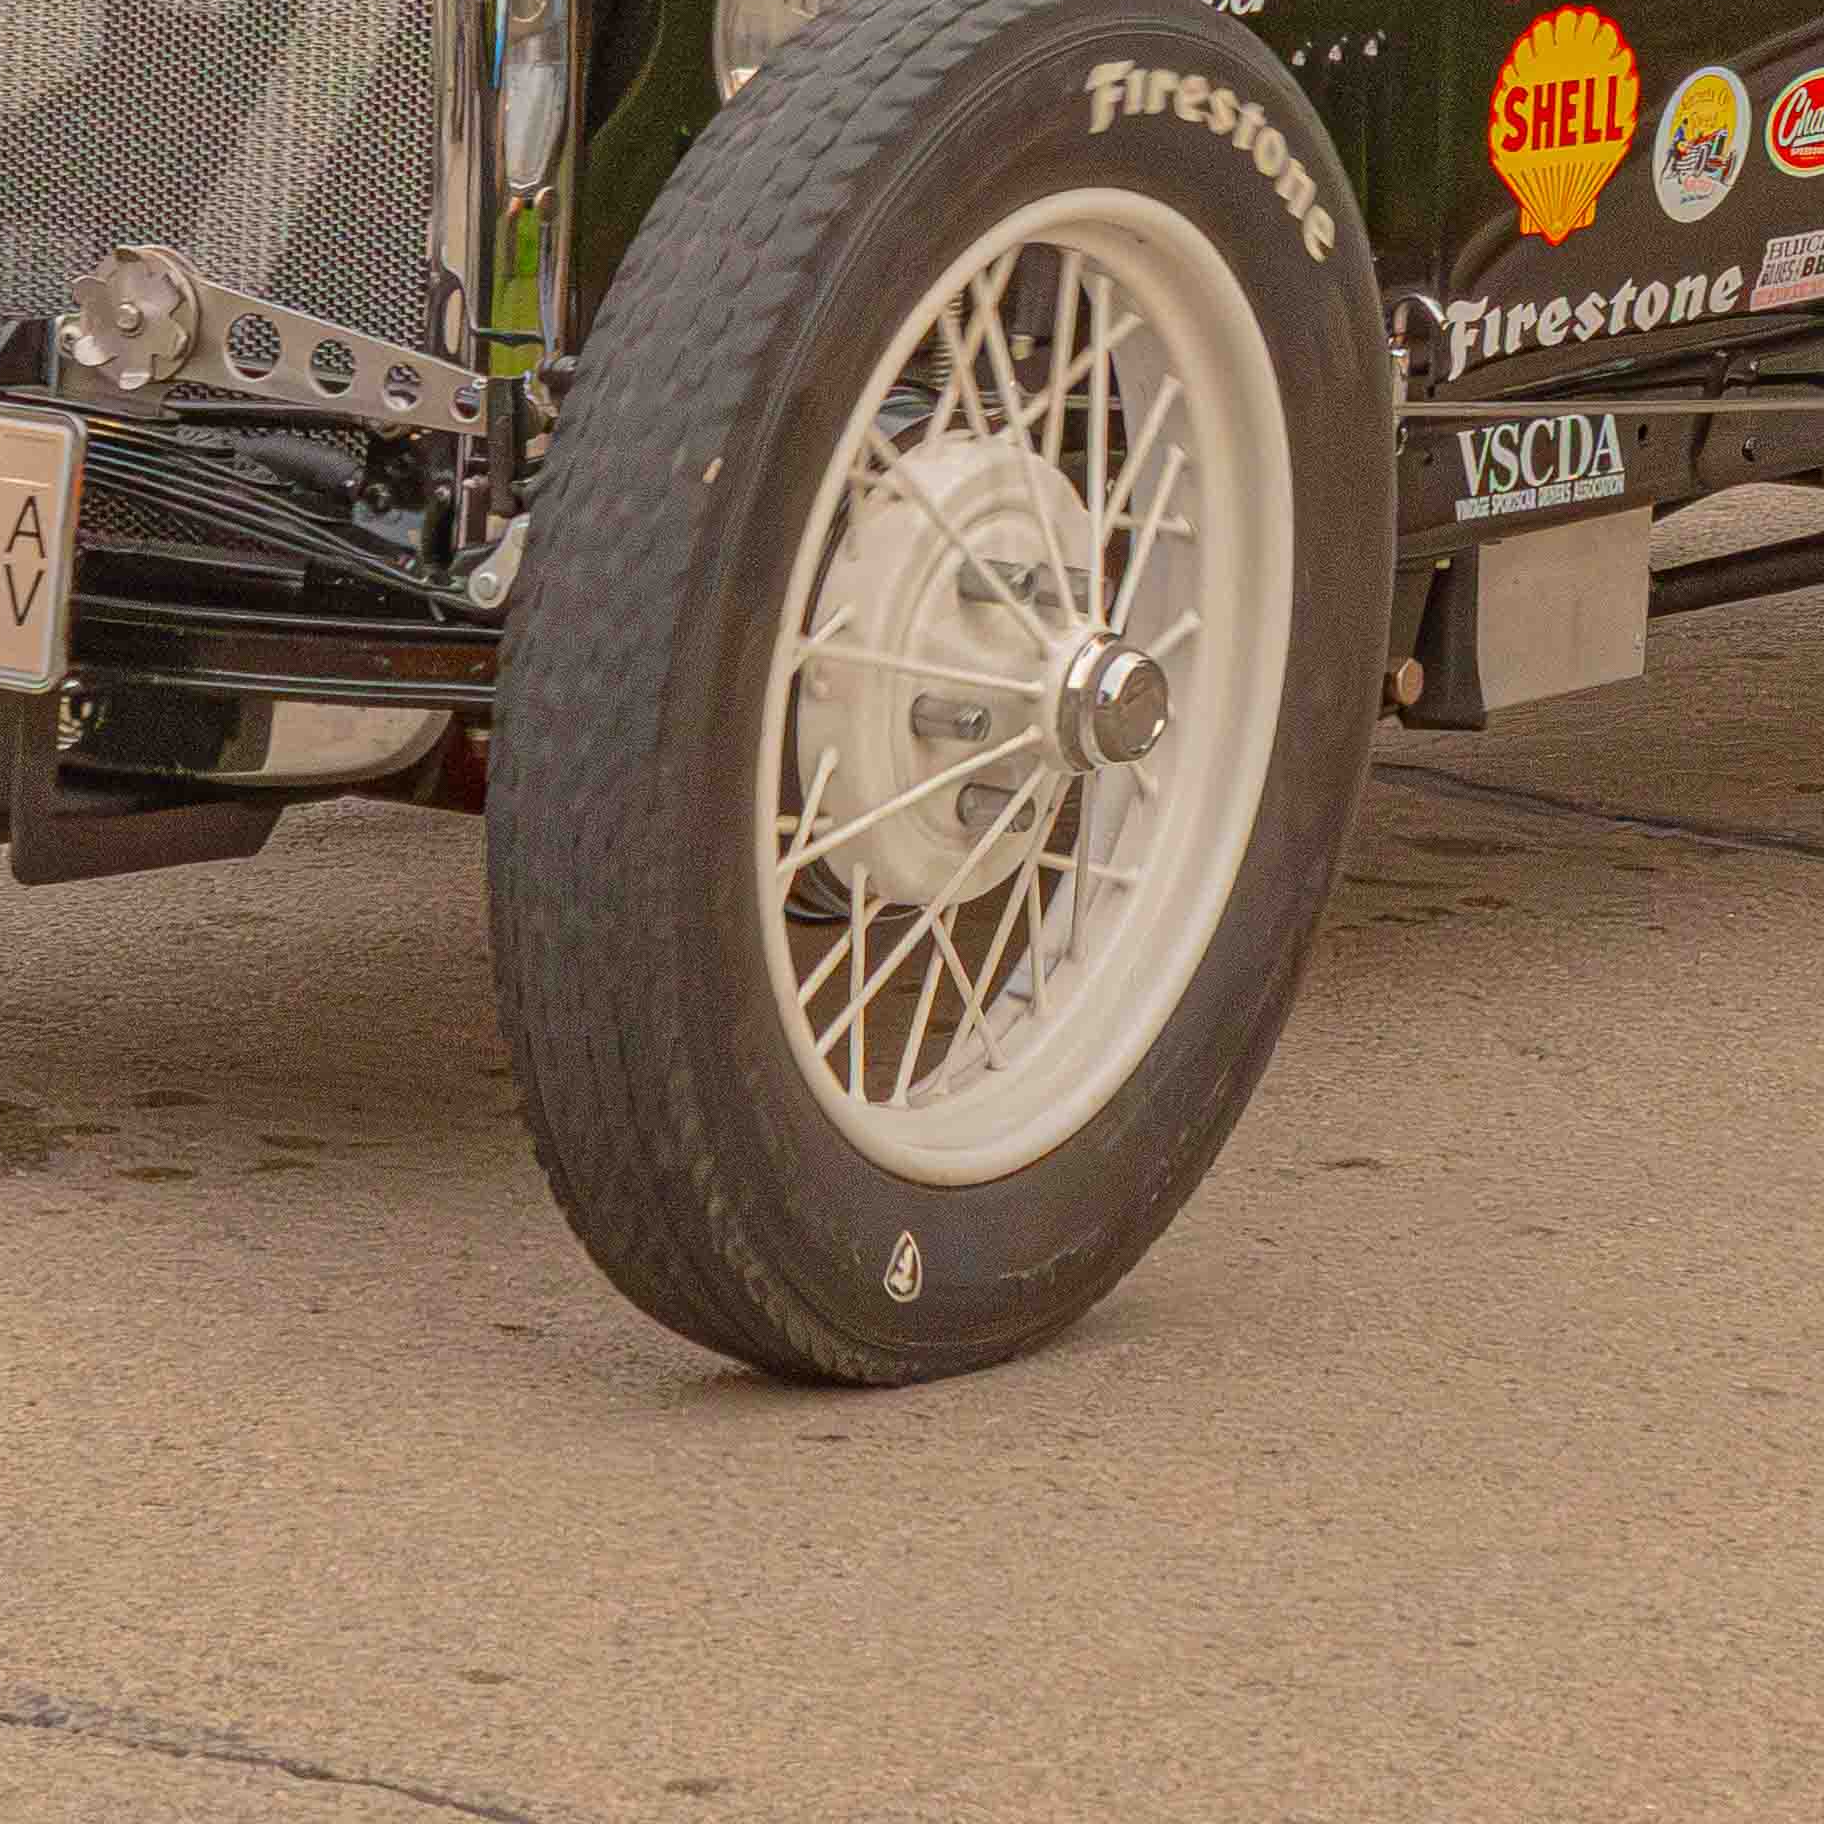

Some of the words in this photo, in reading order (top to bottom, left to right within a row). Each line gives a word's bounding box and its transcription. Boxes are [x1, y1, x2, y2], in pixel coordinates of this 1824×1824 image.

[1084, 59, 1336, 264] Firestone
[1502, 75, 1625, 153] SHELL
[1445, 265, 1744, 383] Firestone
[1455, 413, 1626, 498] VSCDA
